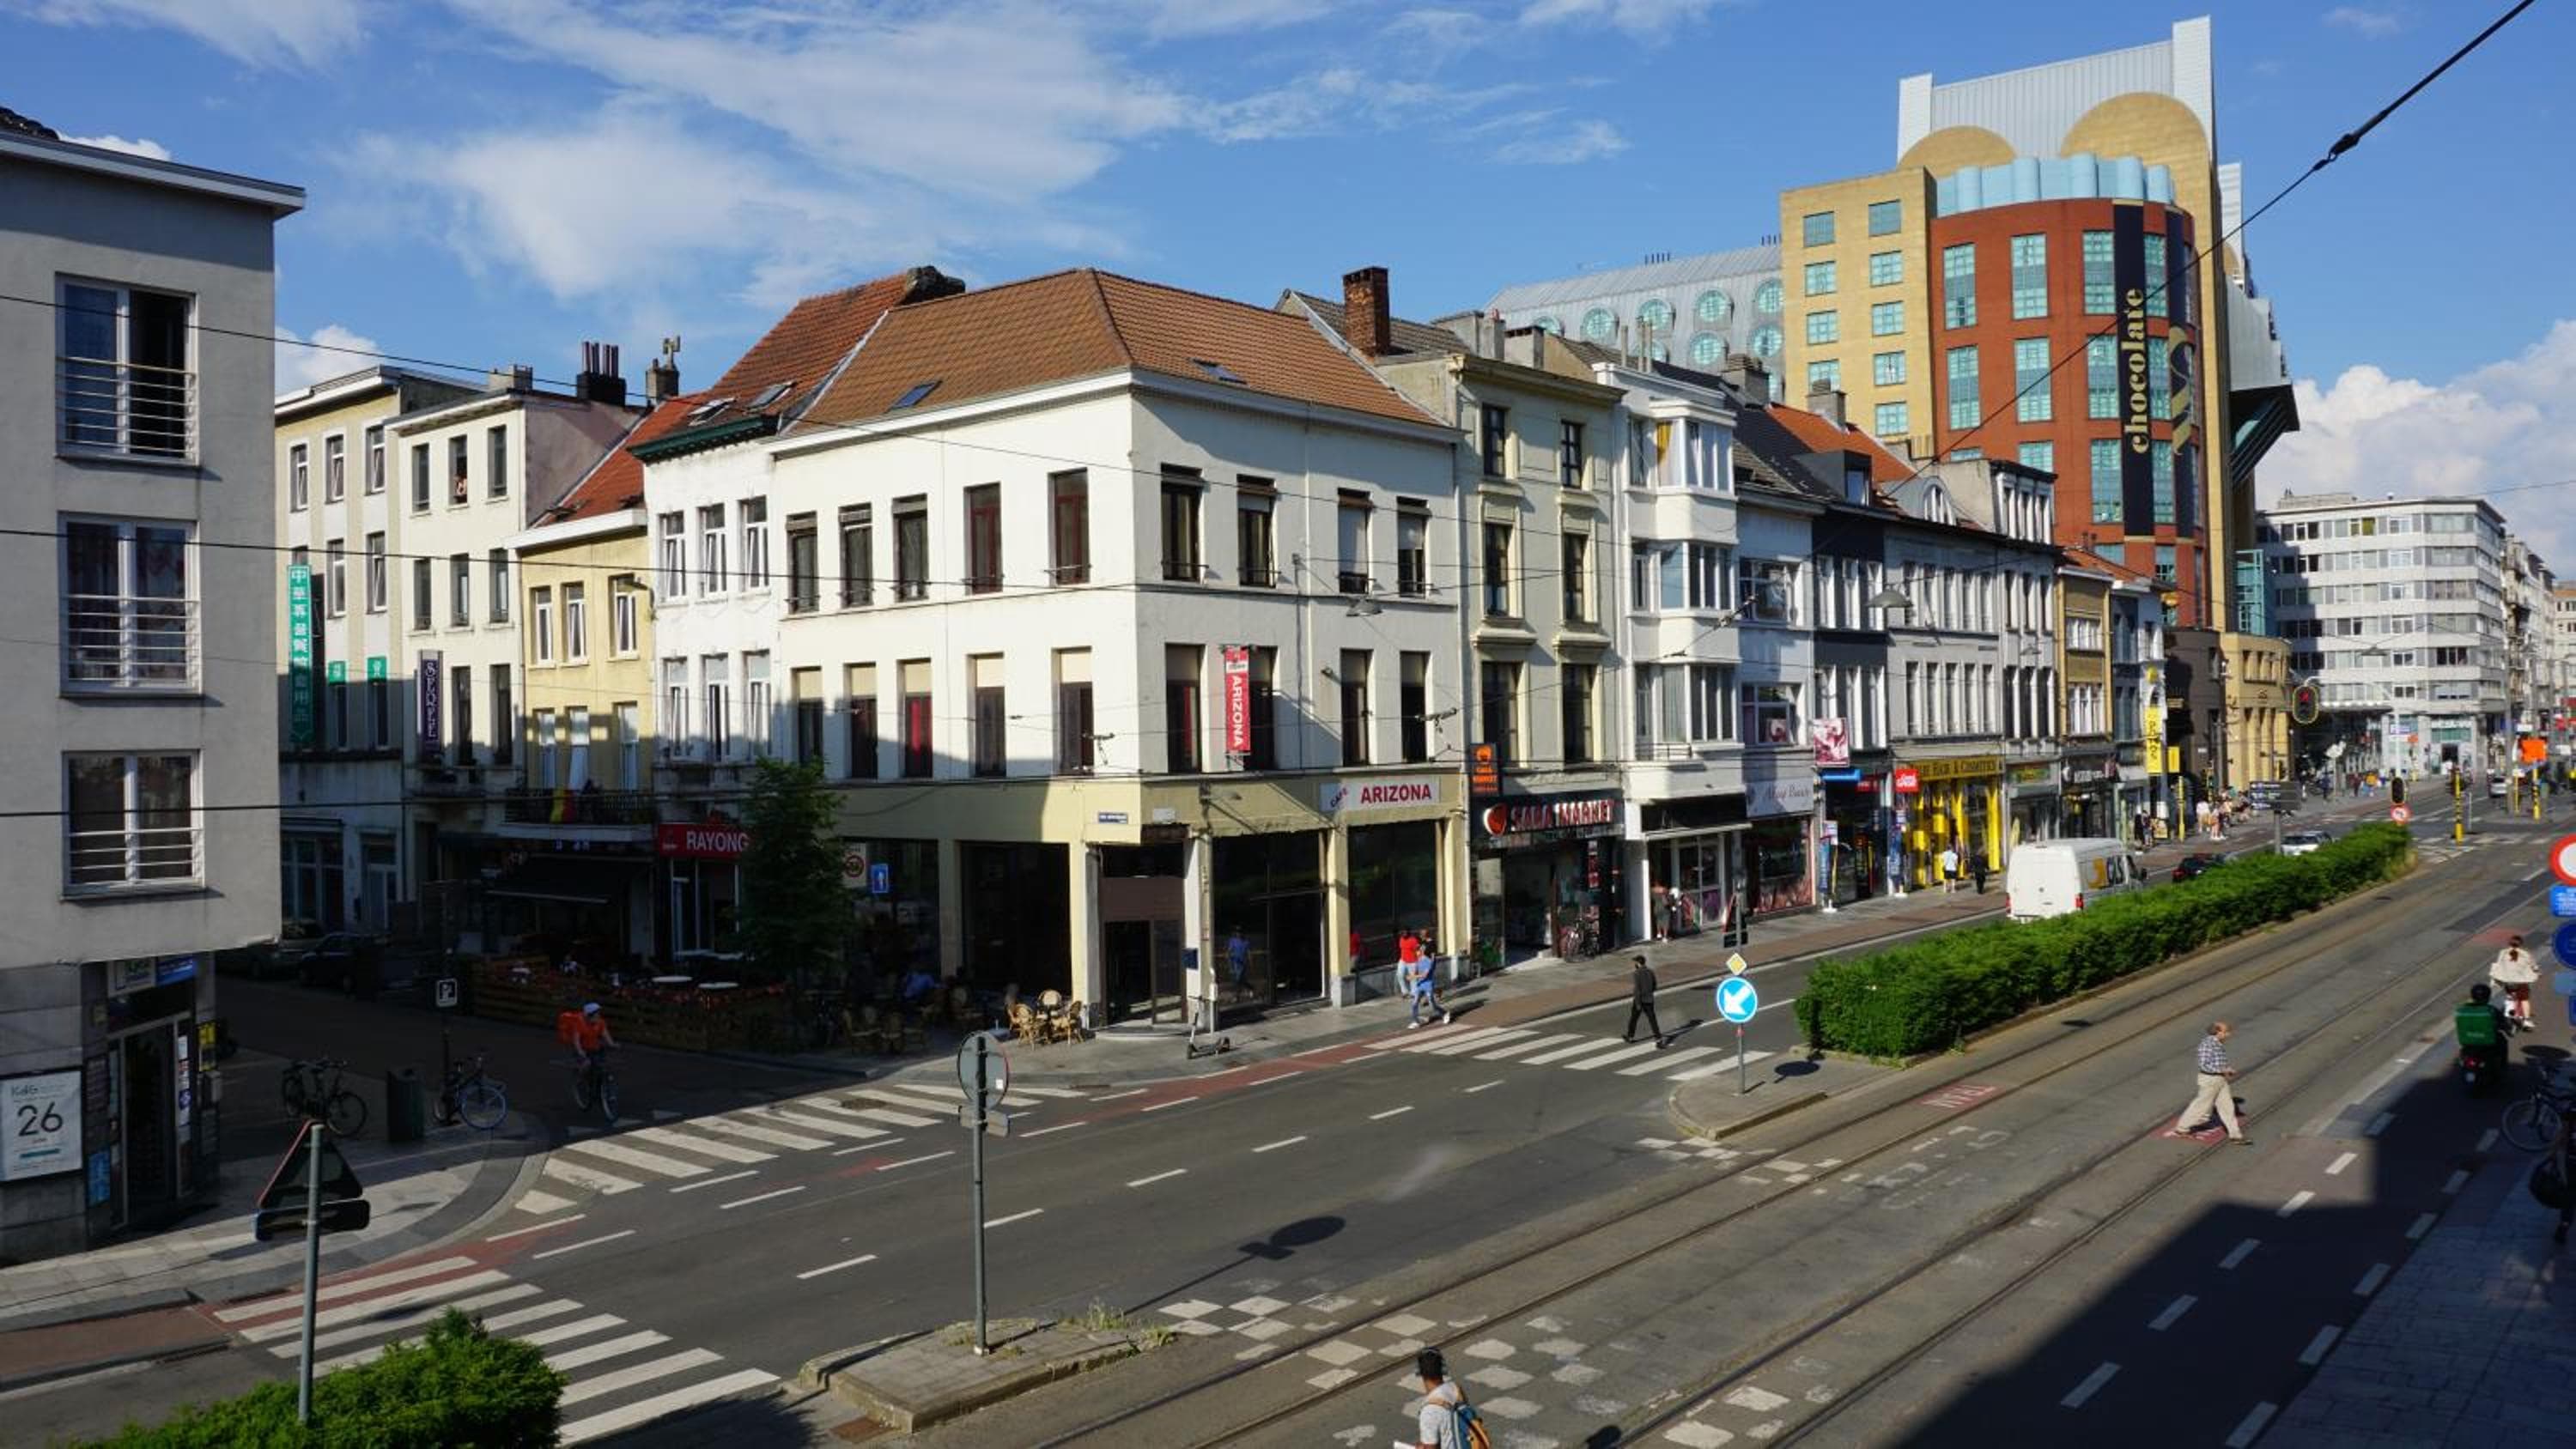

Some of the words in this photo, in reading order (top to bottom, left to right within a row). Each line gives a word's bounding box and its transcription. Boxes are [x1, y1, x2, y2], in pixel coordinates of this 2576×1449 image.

[2121, 288, 2149, 454] chocolate
[1232, 674, 1244, 749] ARIZONA
[1360, 784, 1433, 804] ARIZONA
[1555, 799, 1615, 827] MARKET
[686, 830, 750, 852] RAYONG
[17, 1100, 64, 1137] 26
